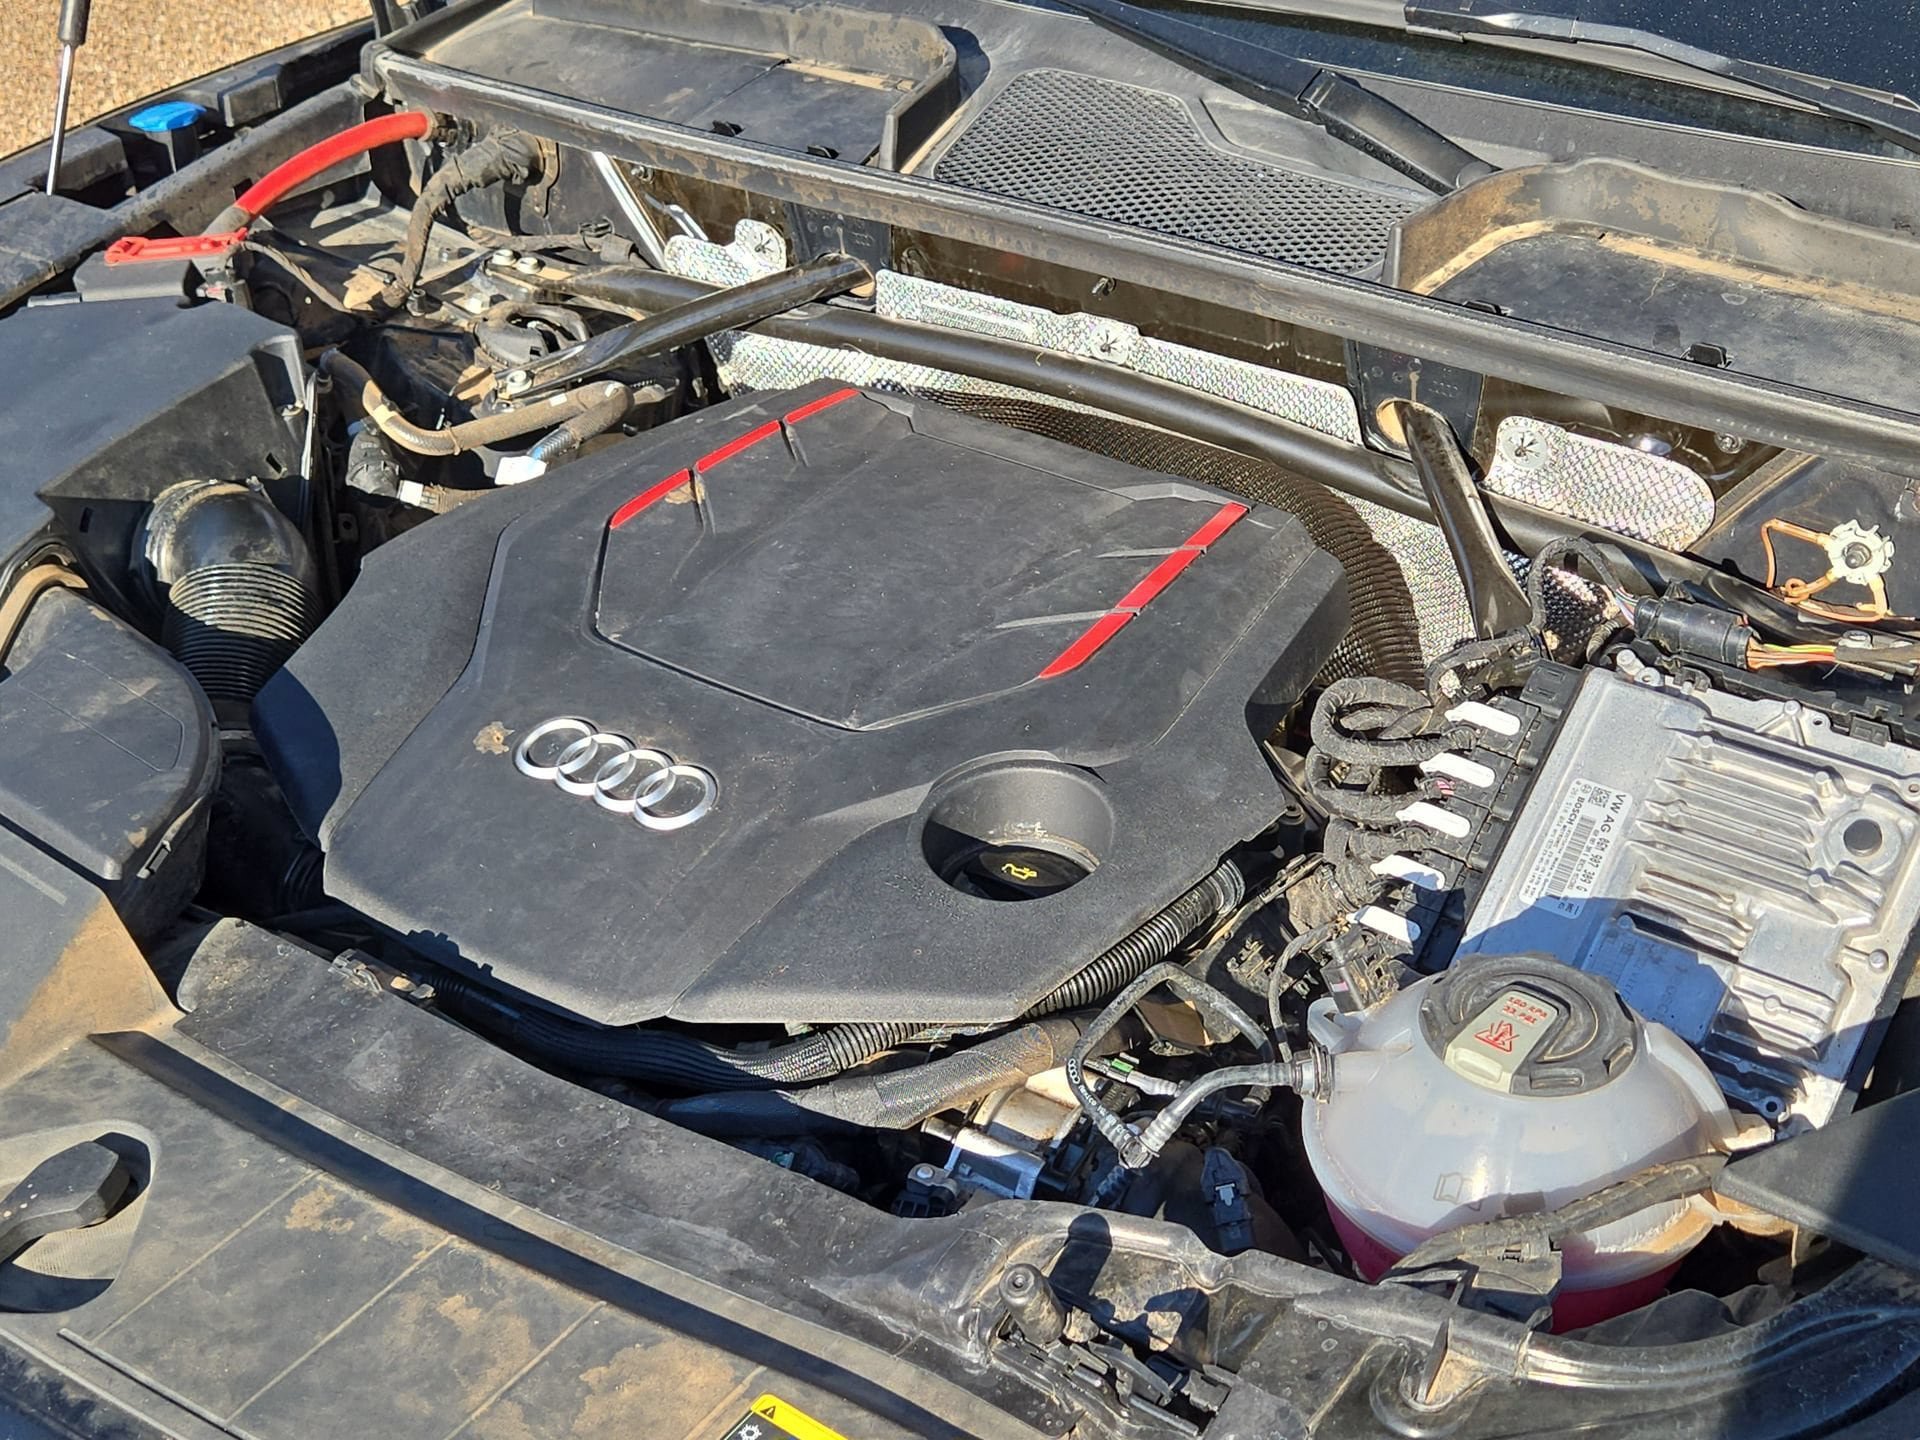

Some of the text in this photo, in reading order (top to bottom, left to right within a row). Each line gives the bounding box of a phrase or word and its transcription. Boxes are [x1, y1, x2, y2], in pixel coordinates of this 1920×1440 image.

[1567, 796, 1586, 826] BOSCH
[1610, 794, 1627, 814] VW
[1600, 814, 1615, 833] AG
